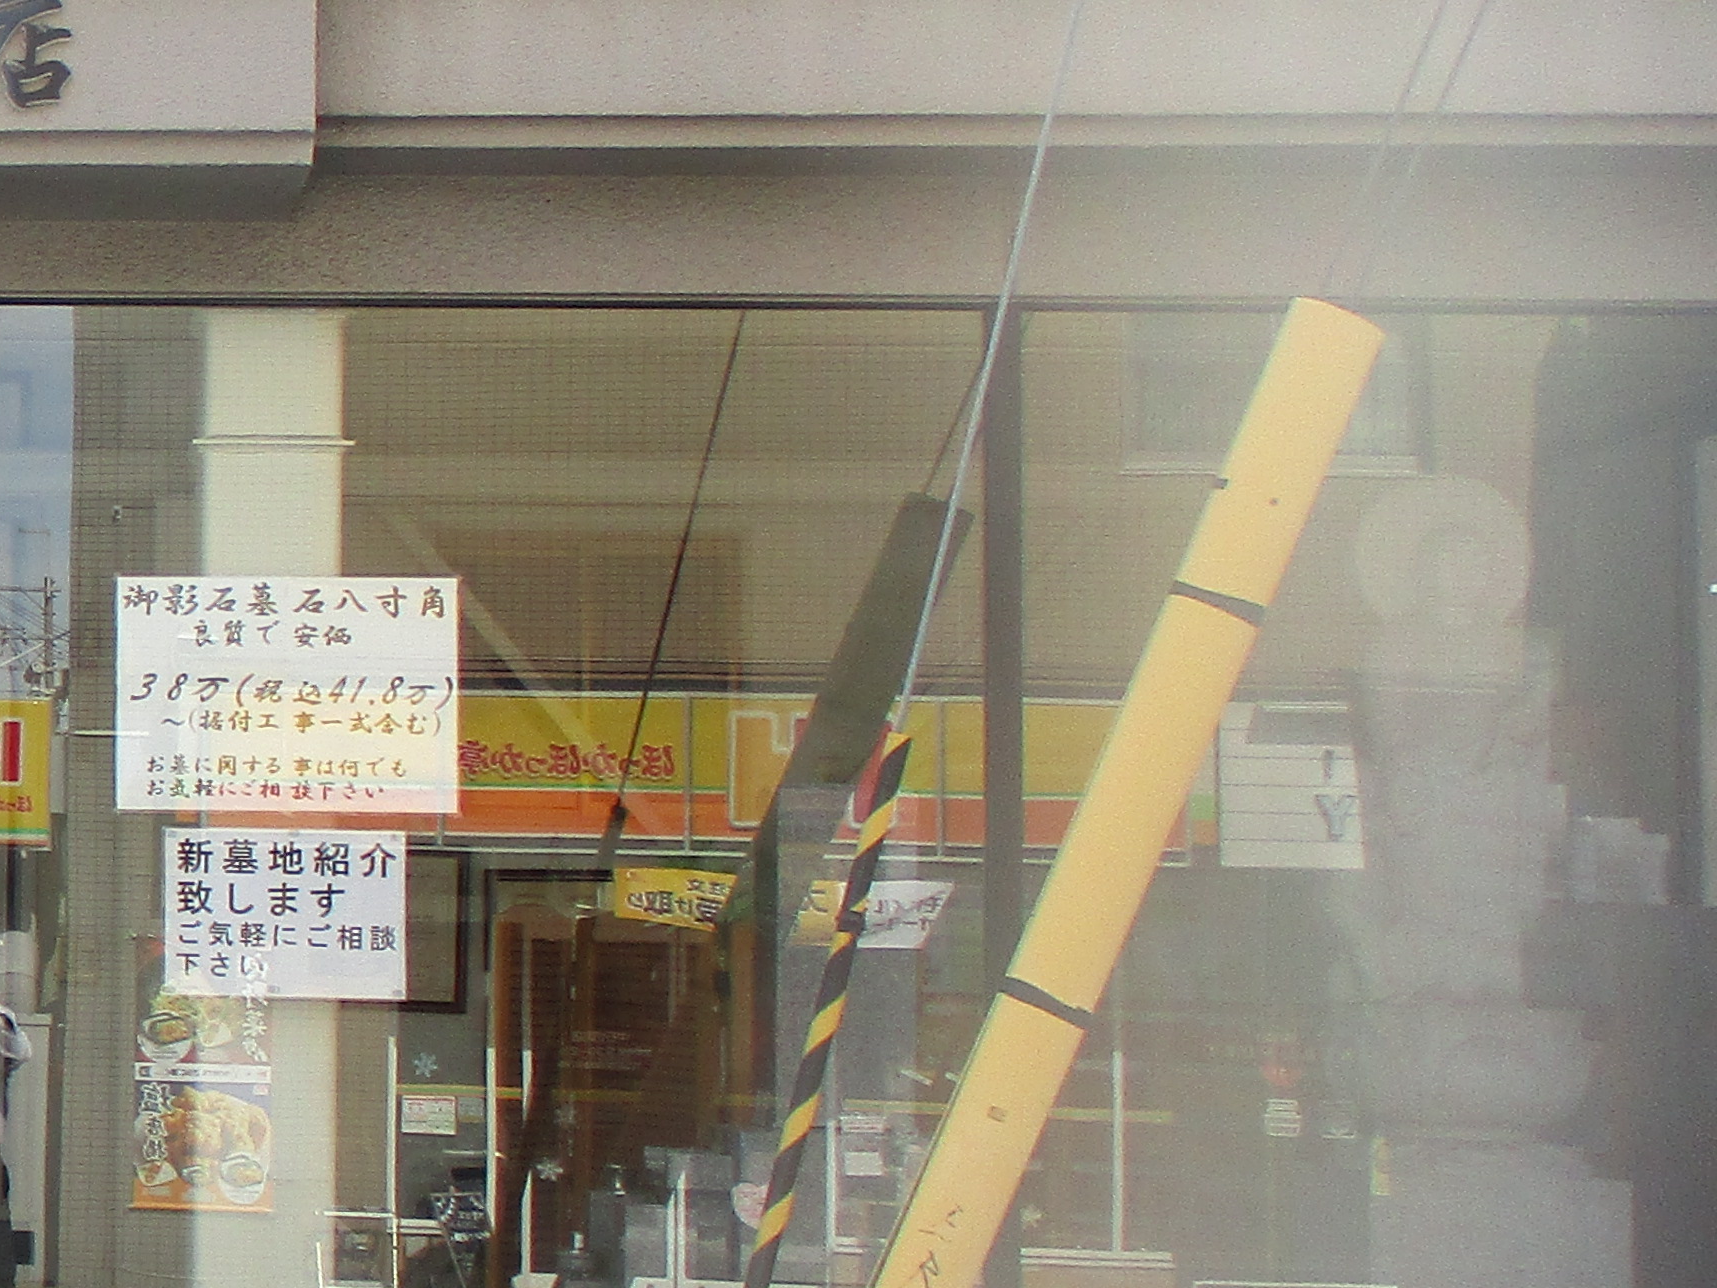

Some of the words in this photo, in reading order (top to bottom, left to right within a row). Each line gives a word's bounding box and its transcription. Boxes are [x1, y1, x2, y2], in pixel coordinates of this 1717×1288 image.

[192, 620, 353, 648] 良質で安価
[147, 755, 408, 777] お墓に関する事は何でも
[147, 778, 386, 800] お気軽にご相談下さい
[177, 839, 398, 878] 新墓地紹介
[176, 880, 345, 917] 致します
[177, 921, 398, 952] ご気軽にご相談
[175, 952, 264, 977] 下さい
